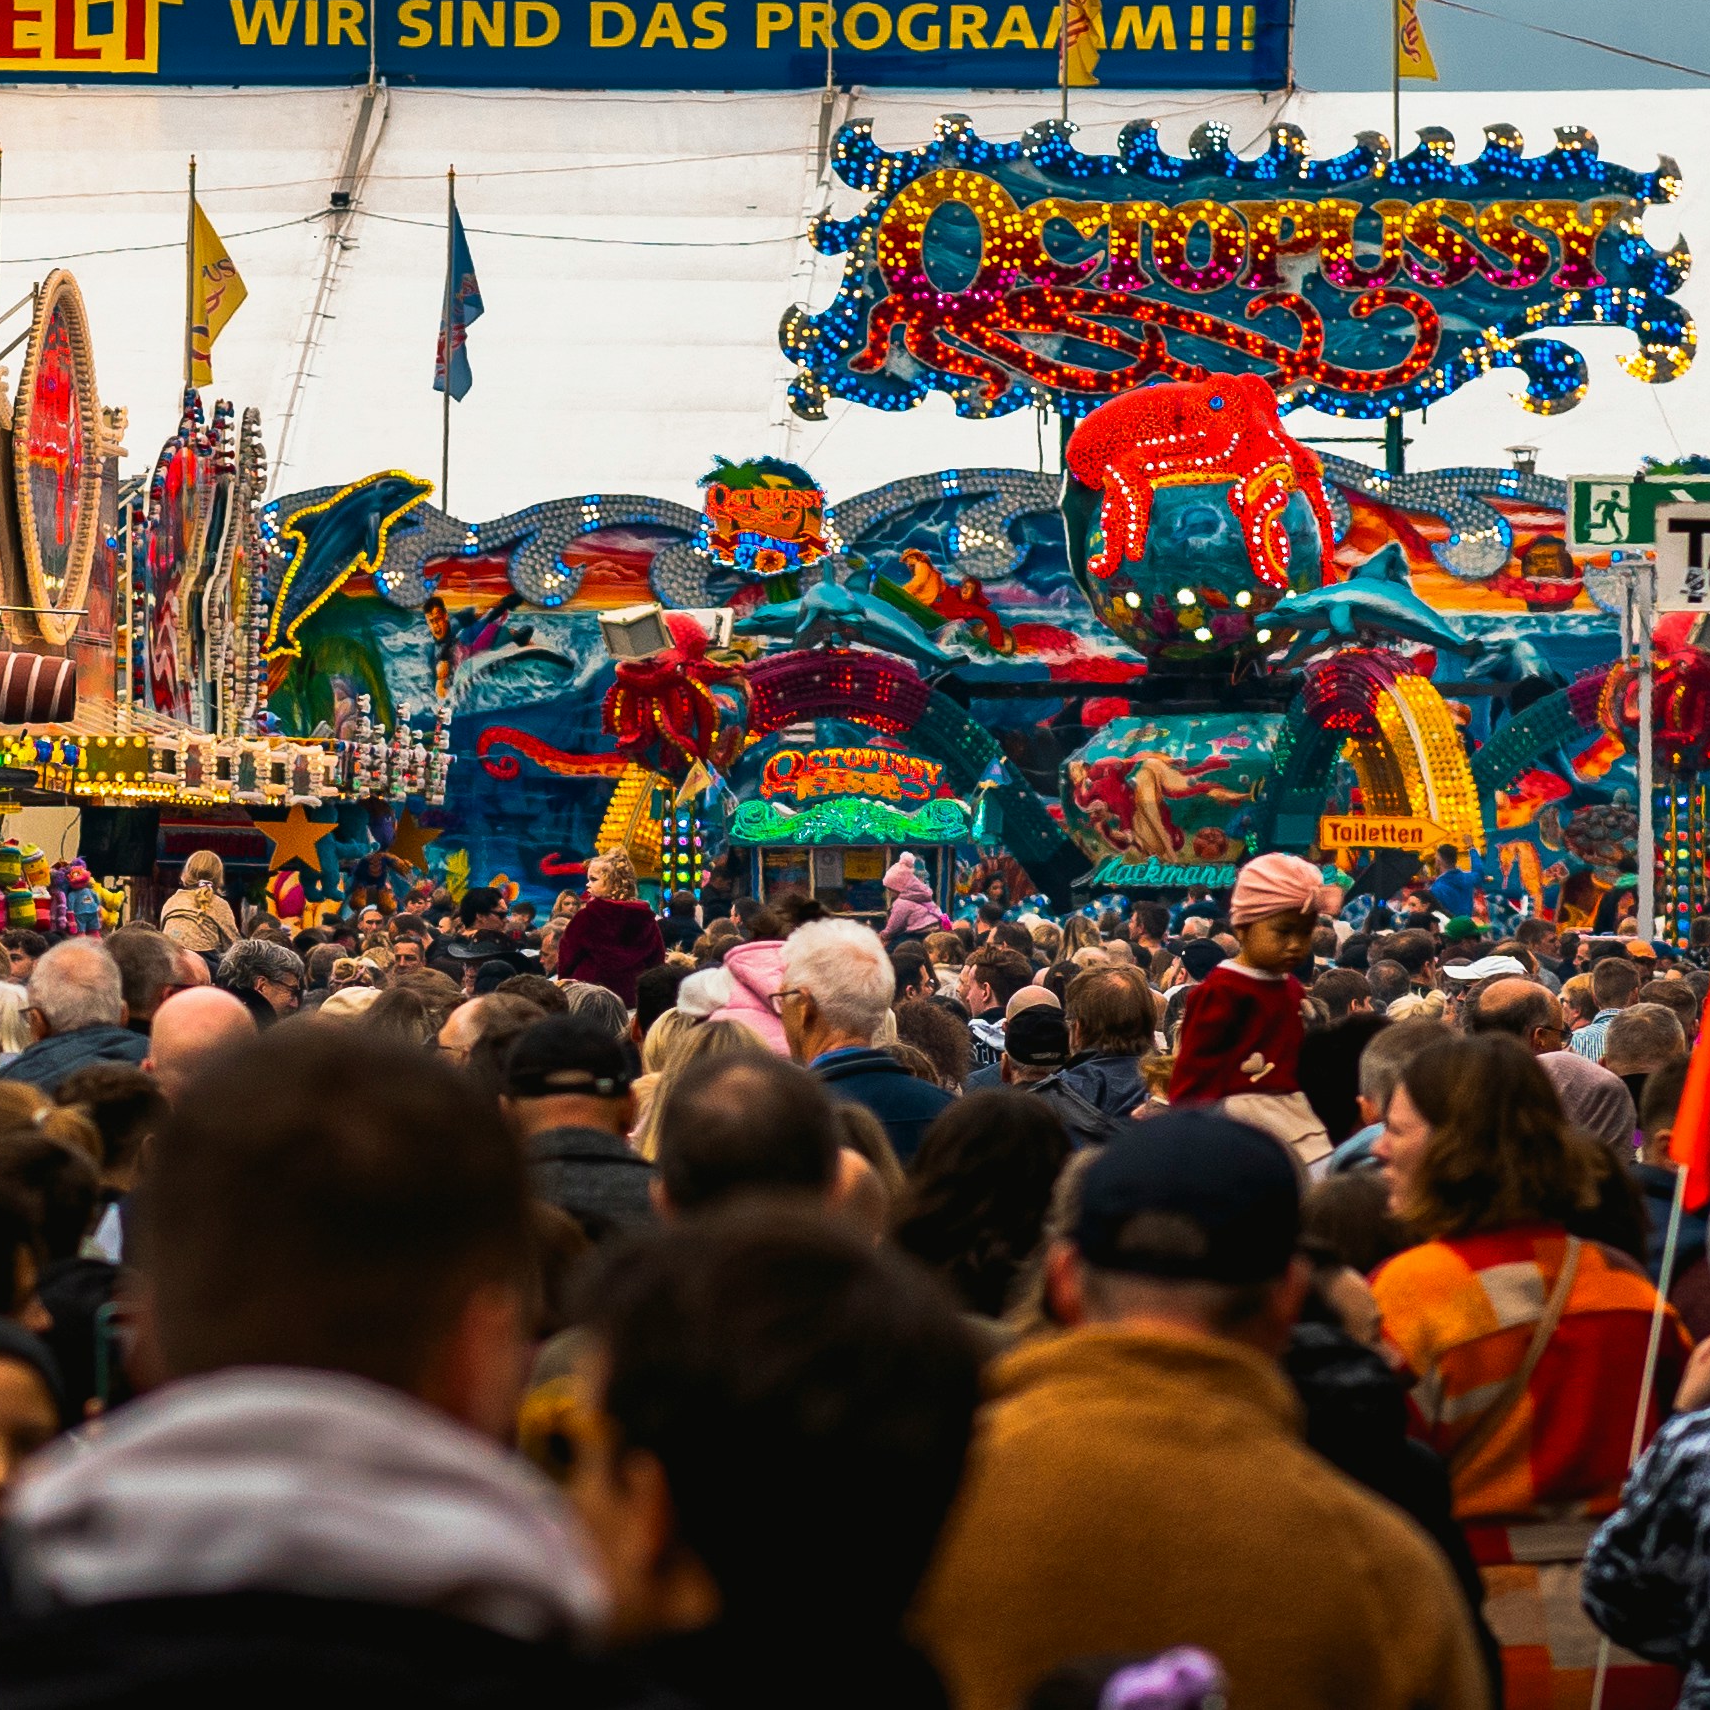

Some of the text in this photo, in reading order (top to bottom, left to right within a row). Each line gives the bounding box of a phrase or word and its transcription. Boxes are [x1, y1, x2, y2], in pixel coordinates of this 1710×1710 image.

[230, 0, 367, 46] WIR
[397, 0, 561, 48] SIND
[589, 0, 728, 49] DAS
[878, 167, 1625, 296] OCTOPUSSY
[1328, 822, 1424, 843] Toiletten
